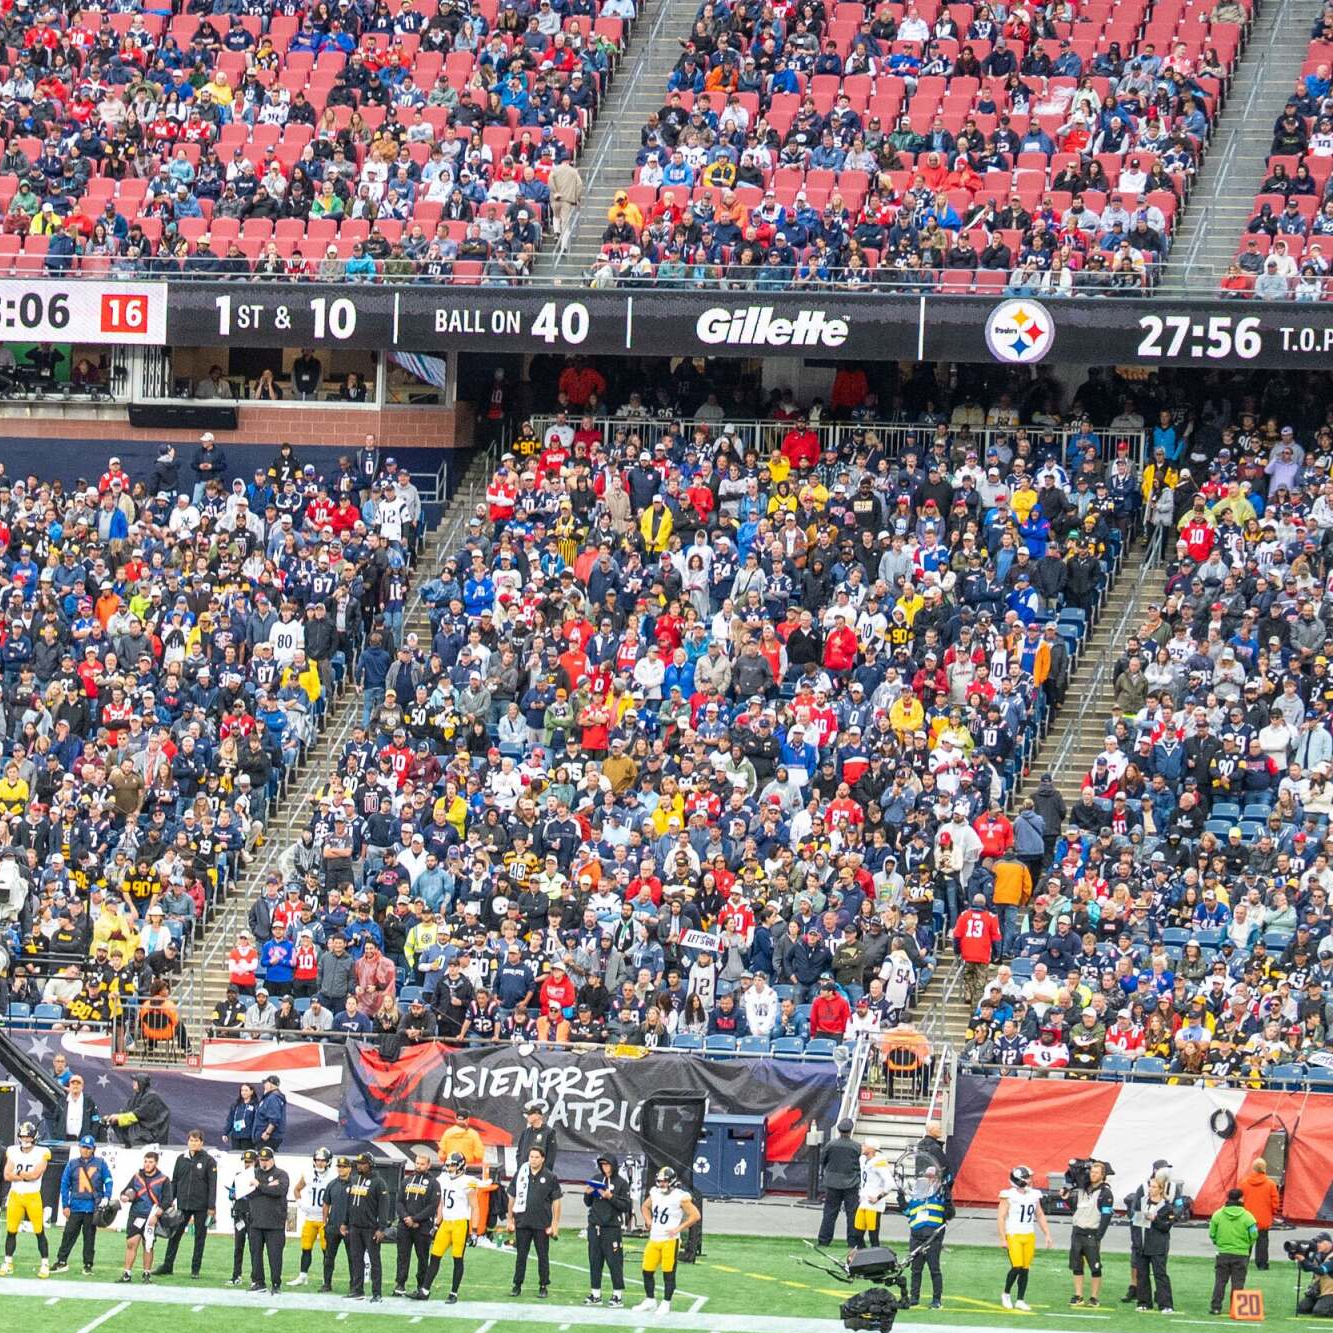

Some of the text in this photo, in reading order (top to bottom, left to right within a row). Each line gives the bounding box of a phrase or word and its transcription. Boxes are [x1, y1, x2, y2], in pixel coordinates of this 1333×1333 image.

[107, 298, 143, 329] 16
[274, 305, 291, 329] &
[310, 298, 357, 339] 10
[435, 302, 589, 344] BALL ON 40
[696, 307, 851, 347] Gillette
[1137, 315, 1261, 359] 27:56
[1189, 528, 1204, 544] 10
[313, 577, 333, 594] 87
[277, 633, 293, 649] 80
[965, 919, 986, 939] 13
[297, 953, 314, 970] 10
[1020, 1204, 1034, 1223] 19
[1237, 1295, 1260, 1315] 20
